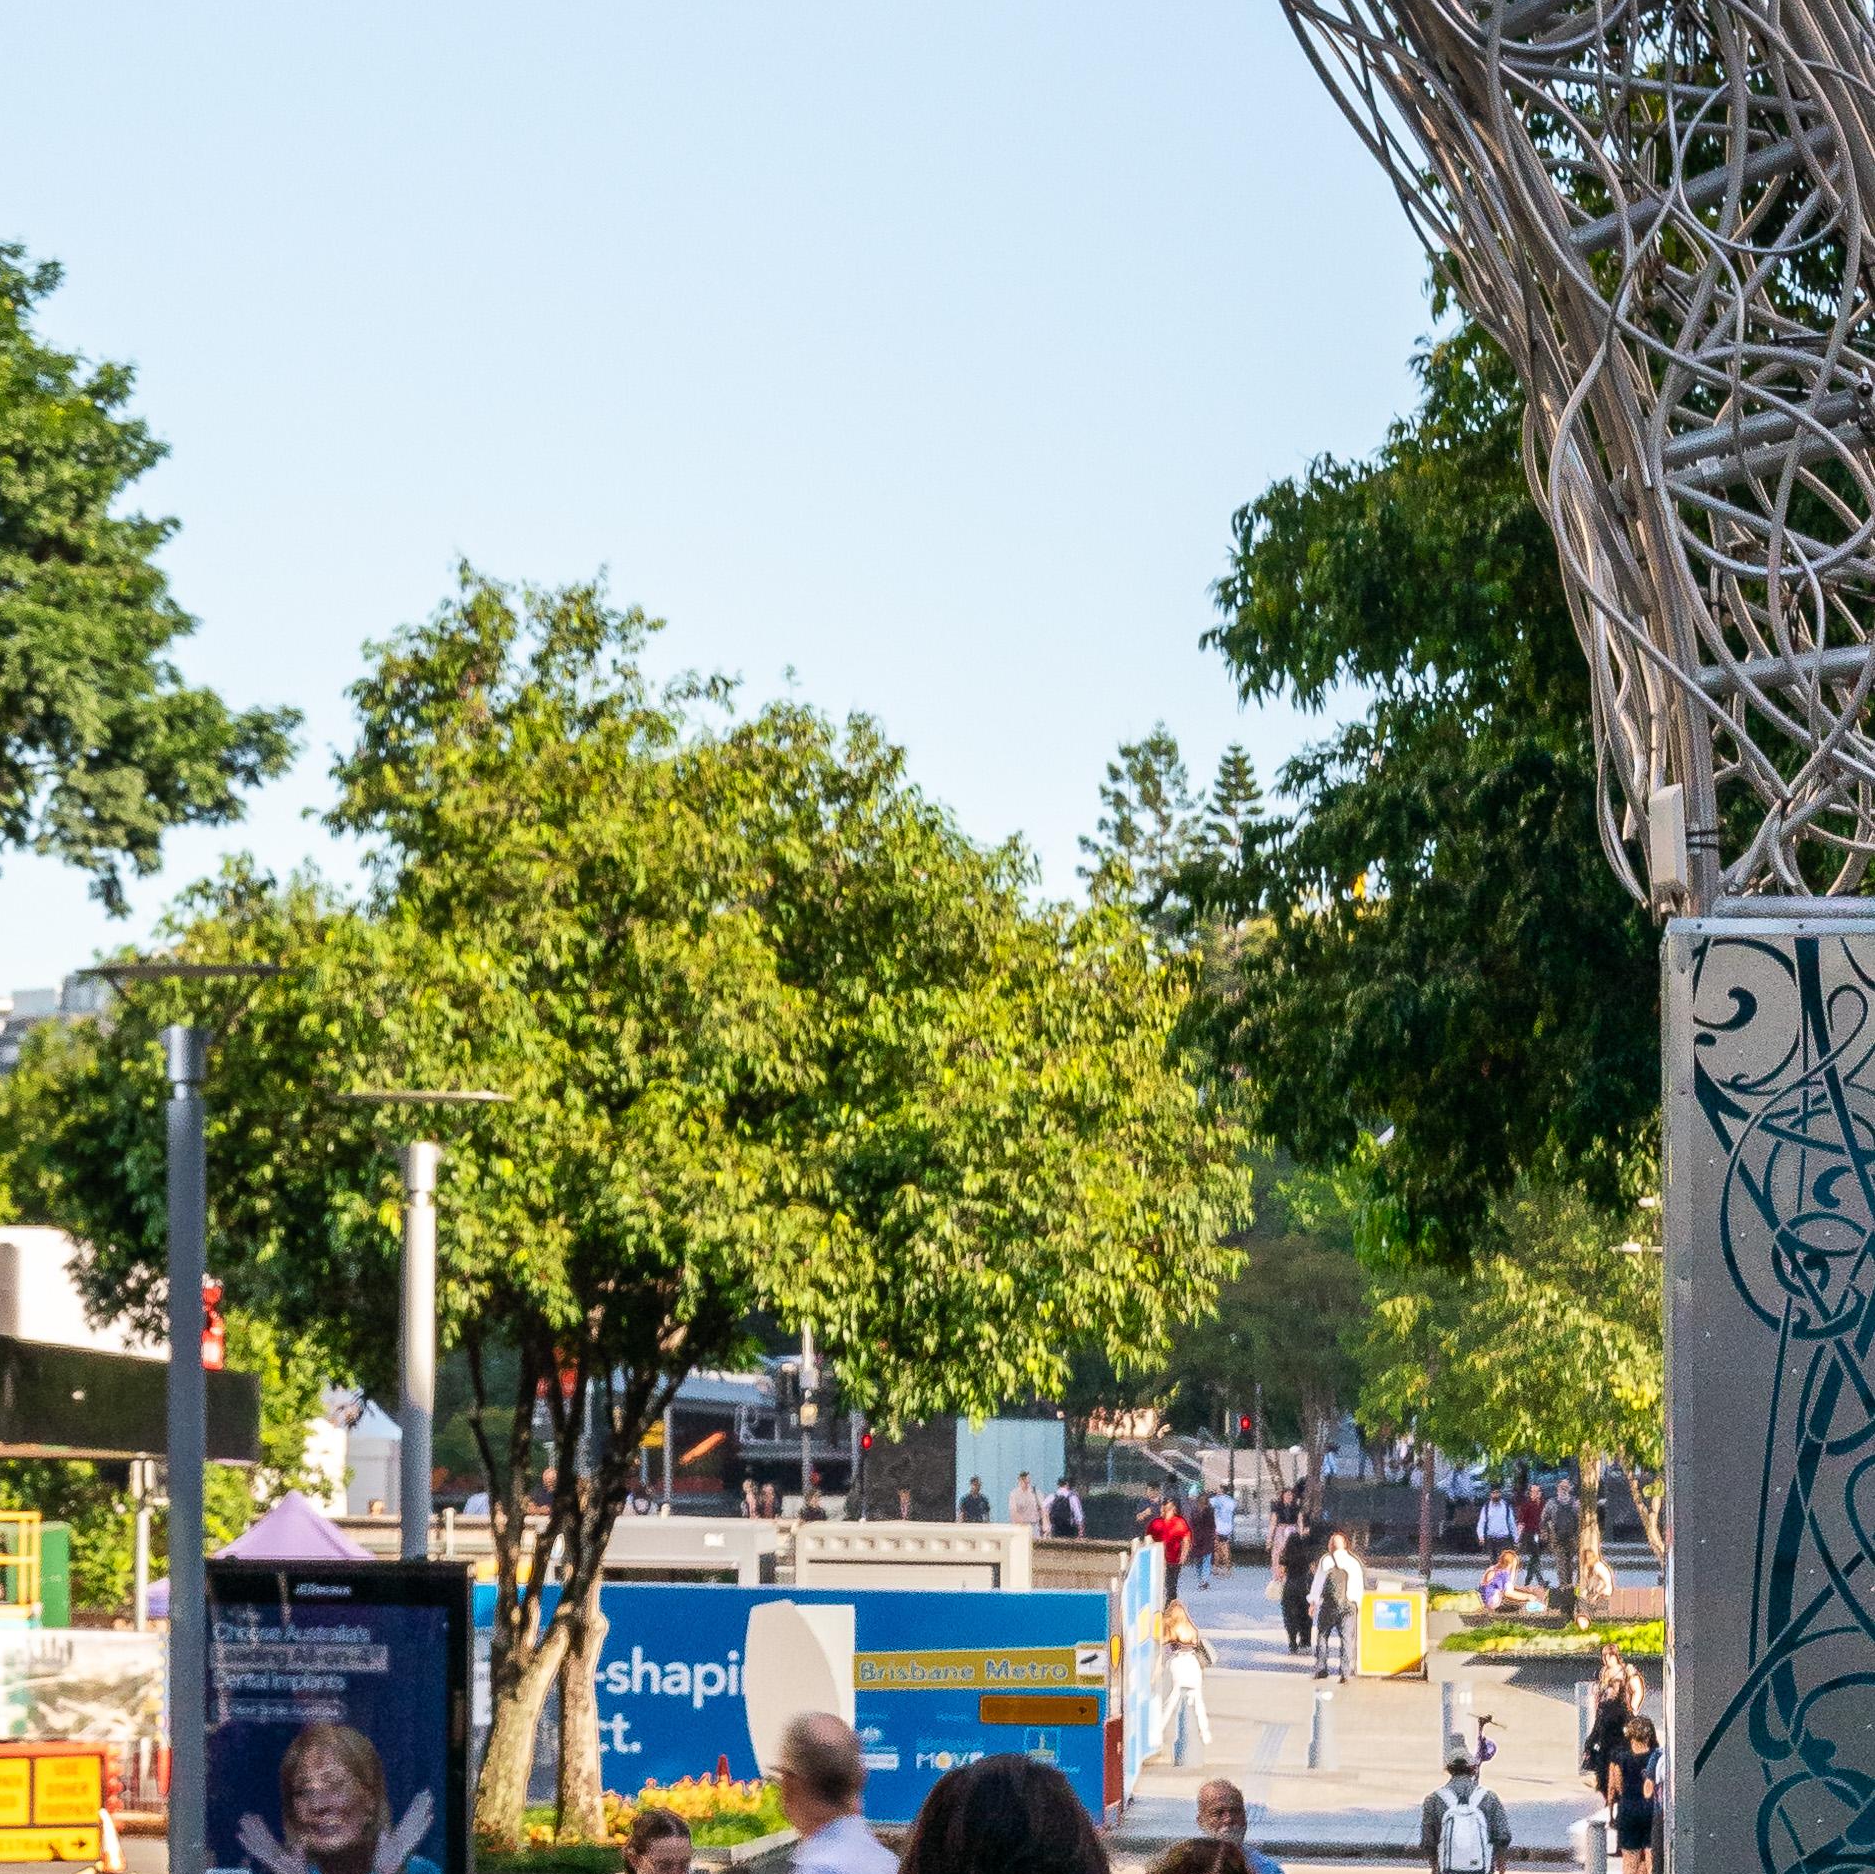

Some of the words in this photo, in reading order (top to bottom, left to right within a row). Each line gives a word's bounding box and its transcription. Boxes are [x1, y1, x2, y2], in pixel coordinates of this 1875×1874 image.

[216, 1646, 288, 1668] eading
[595, 1645, 743, 1710] -shapi
[859, 1659, 975, 1682] Brisbane
[984, 1659, 1069, 1680] Metro
